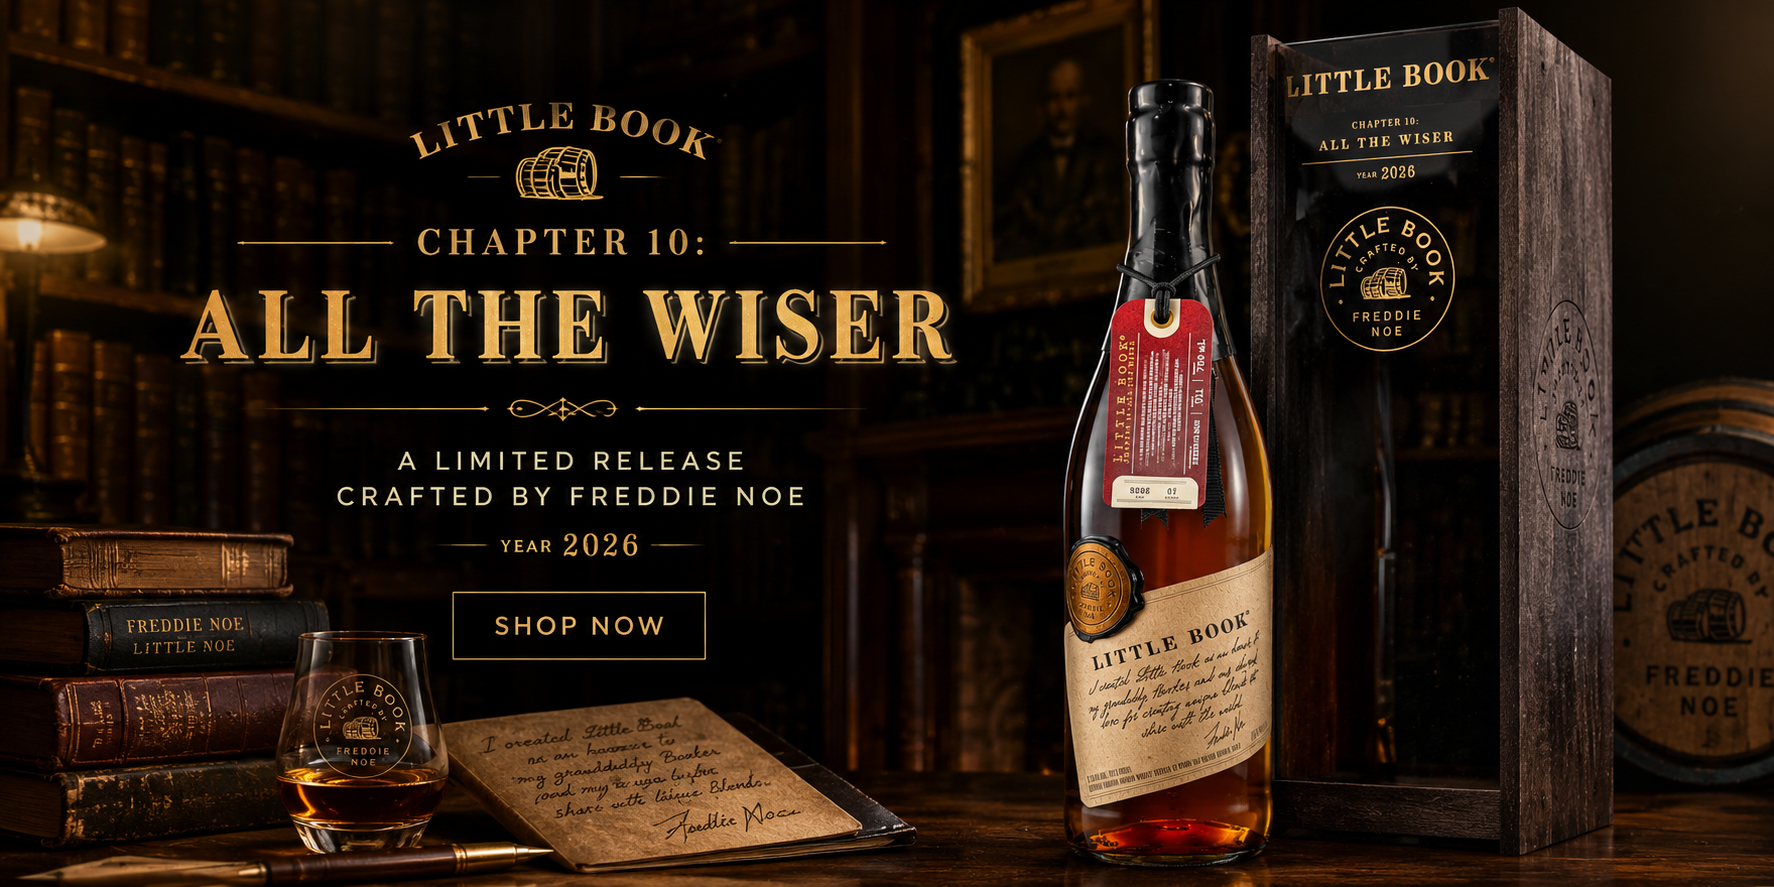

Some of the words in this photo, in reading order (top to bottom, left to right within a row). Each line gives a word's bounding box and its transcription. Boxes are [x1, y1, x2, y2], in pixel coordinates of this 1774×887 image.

[1286, 66, 1392, 98] LITTLE
[1351, 117, 1401, 130] CHAPTER
[1404, 116, 1419, 127] 10:
[1318, 138, 1350, 152] ALL
[1357, 135, 1391, 149] THE
[1399, 130, 1454, 146] WISER
[1356, 170, 1378, 180] YEAR
[1381, 164, 1416, 181] 2026
[1329, 216, 1390, 289] LITTLE
[1400, 219, 1445, 287] BOOK
[1352, 309, 1421, 323] FREDDIE
[1371, 326, 1402, 337] NOE
[1112, 395, 1126, 463] LITTLE
[1653, 545, 1745, 592] CRAFTED
[126, 618, 203, 633] FREDDIE
[209, 617, 244, 632] NOE
[133, 640, 196, 655] LITTLE
[203, 639, 235, 652] NOE
[1091, 635, 1178, 671] LITTLE
[1645, 665, 1774, 688] FREDDIE
[320, 681, 365, 729] LITTLE
[373, 684, 406, 732] BOOK
[1680, 696, 1738, 717] NOE
[350, 758, 376, 767] NOE
